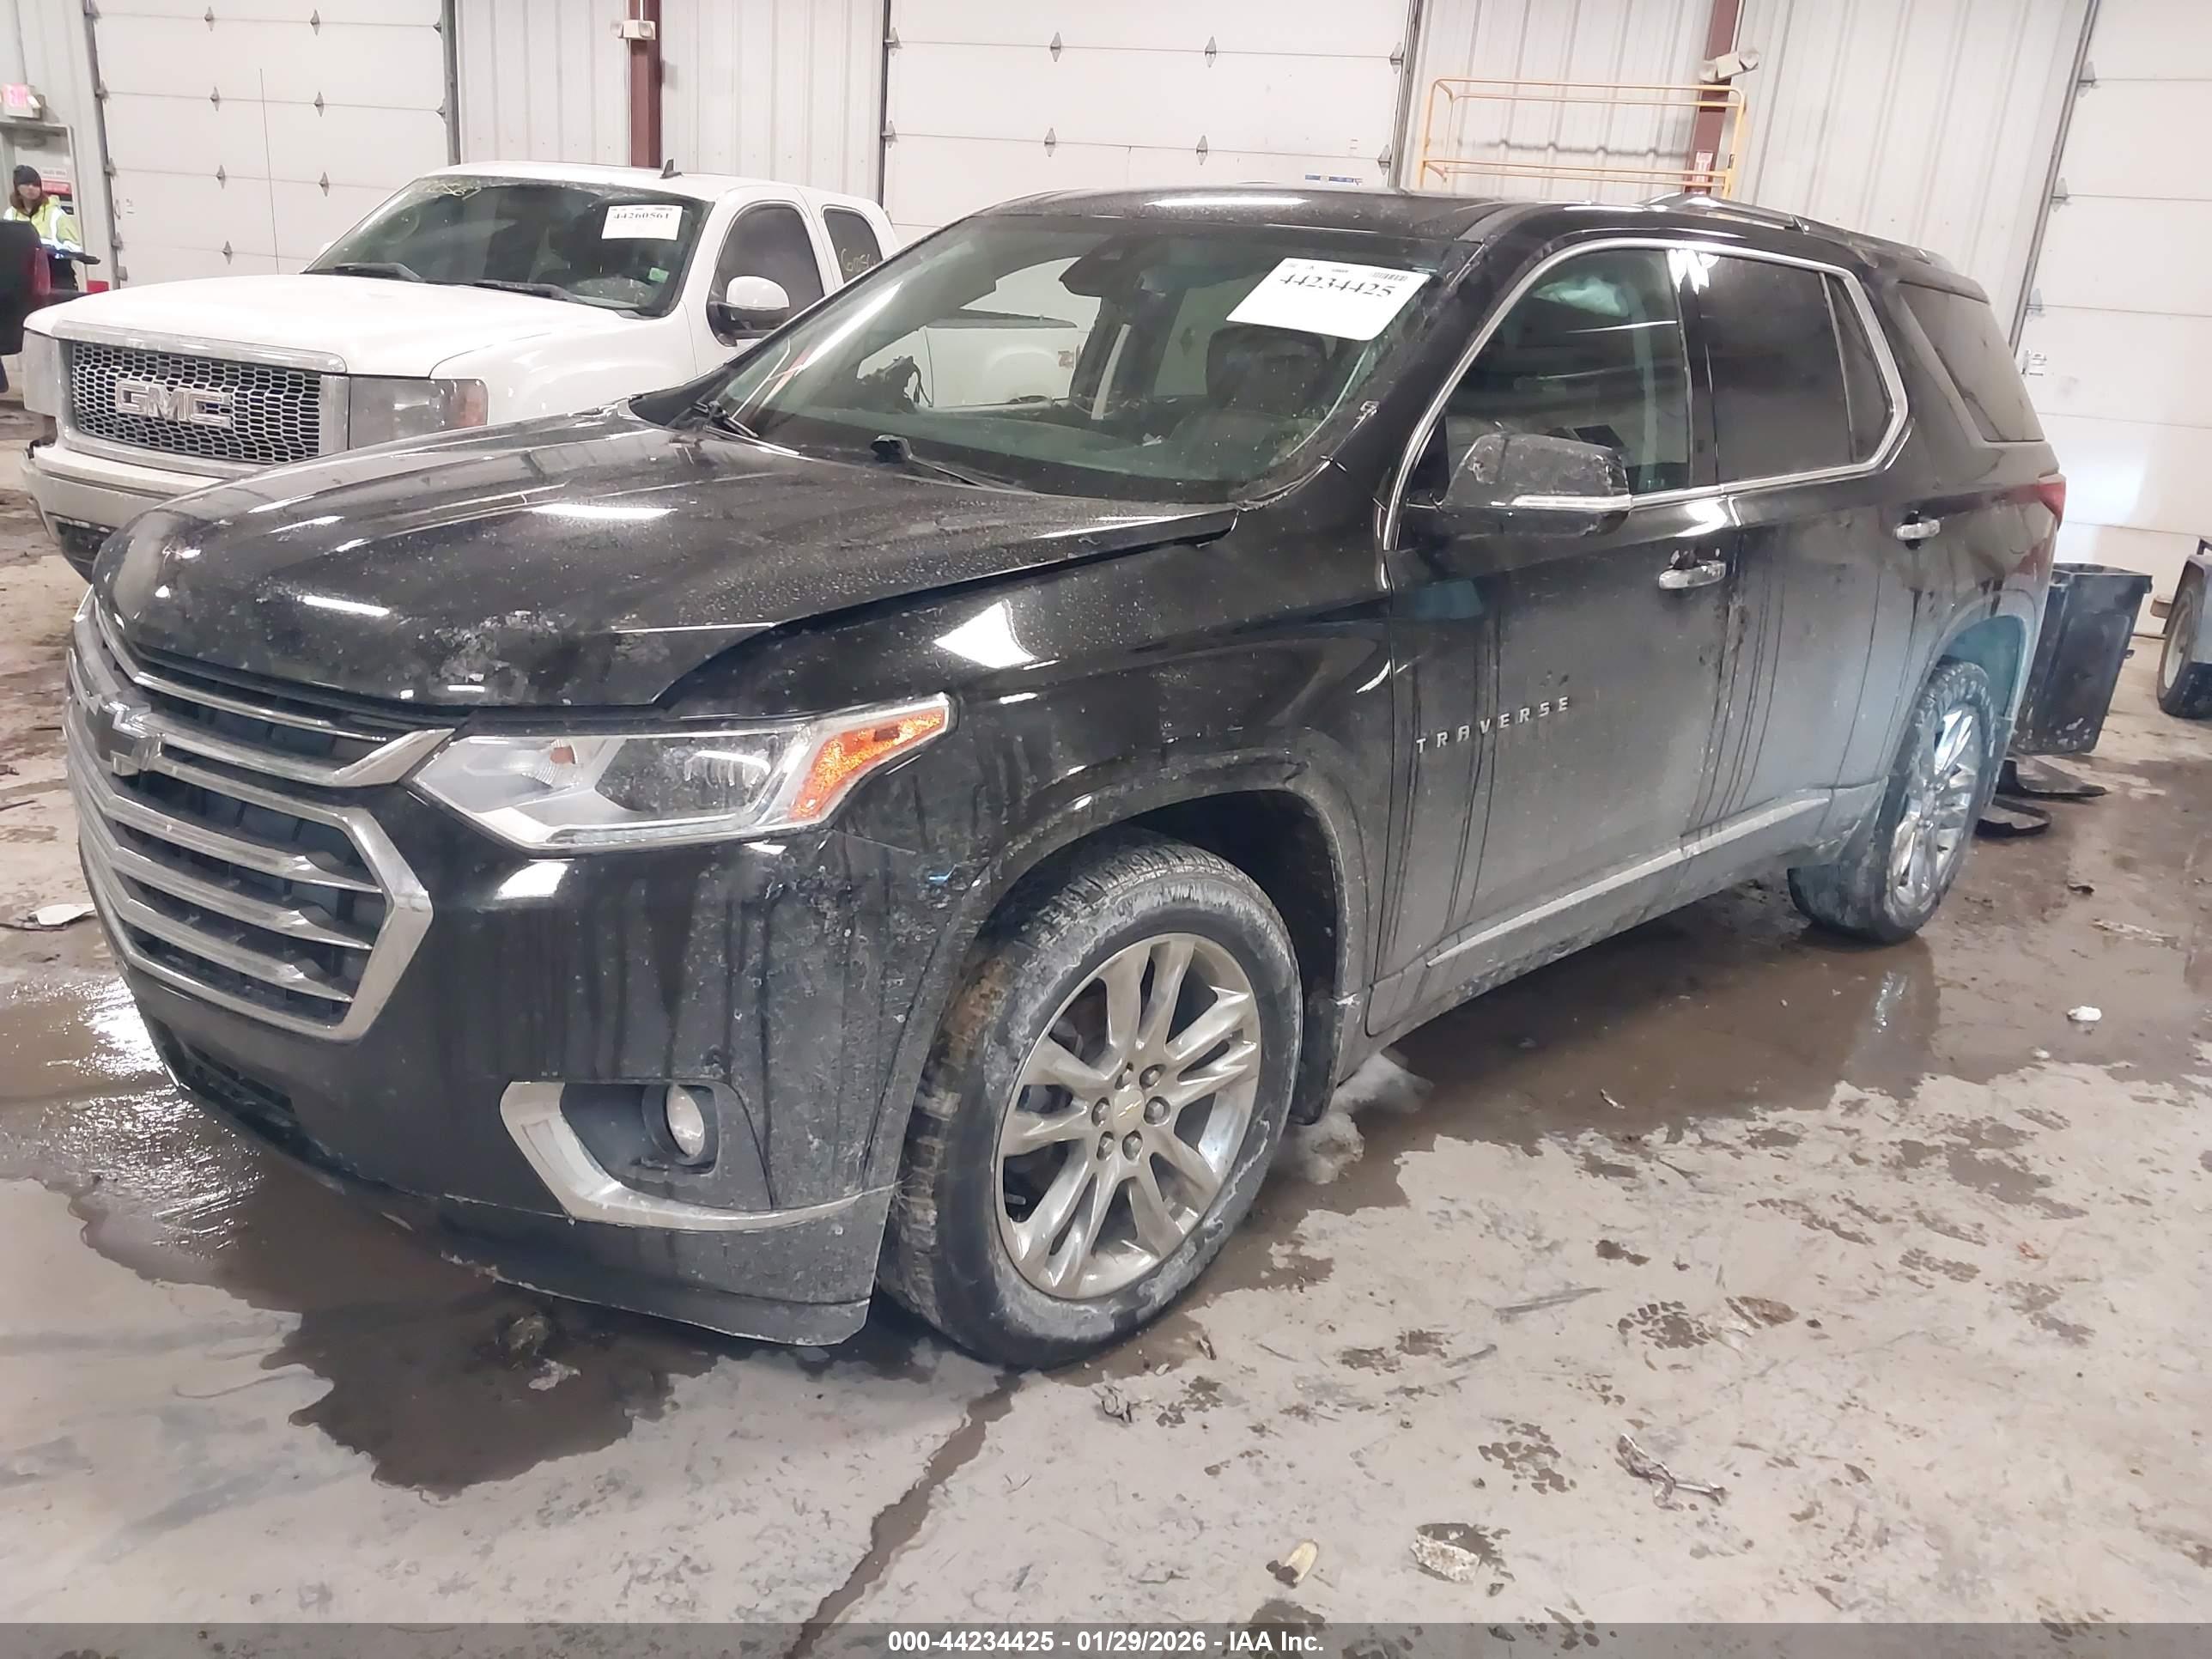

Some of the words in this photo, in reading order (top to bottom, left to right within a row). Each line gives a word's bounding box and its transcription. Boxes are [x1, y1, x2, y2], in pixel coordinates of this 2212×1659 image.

[1279, 274, 1395, 296] 44234425
[115, 380, 232, 429] GMC
[1416, 696, 1569, 754] TRAVERSE
